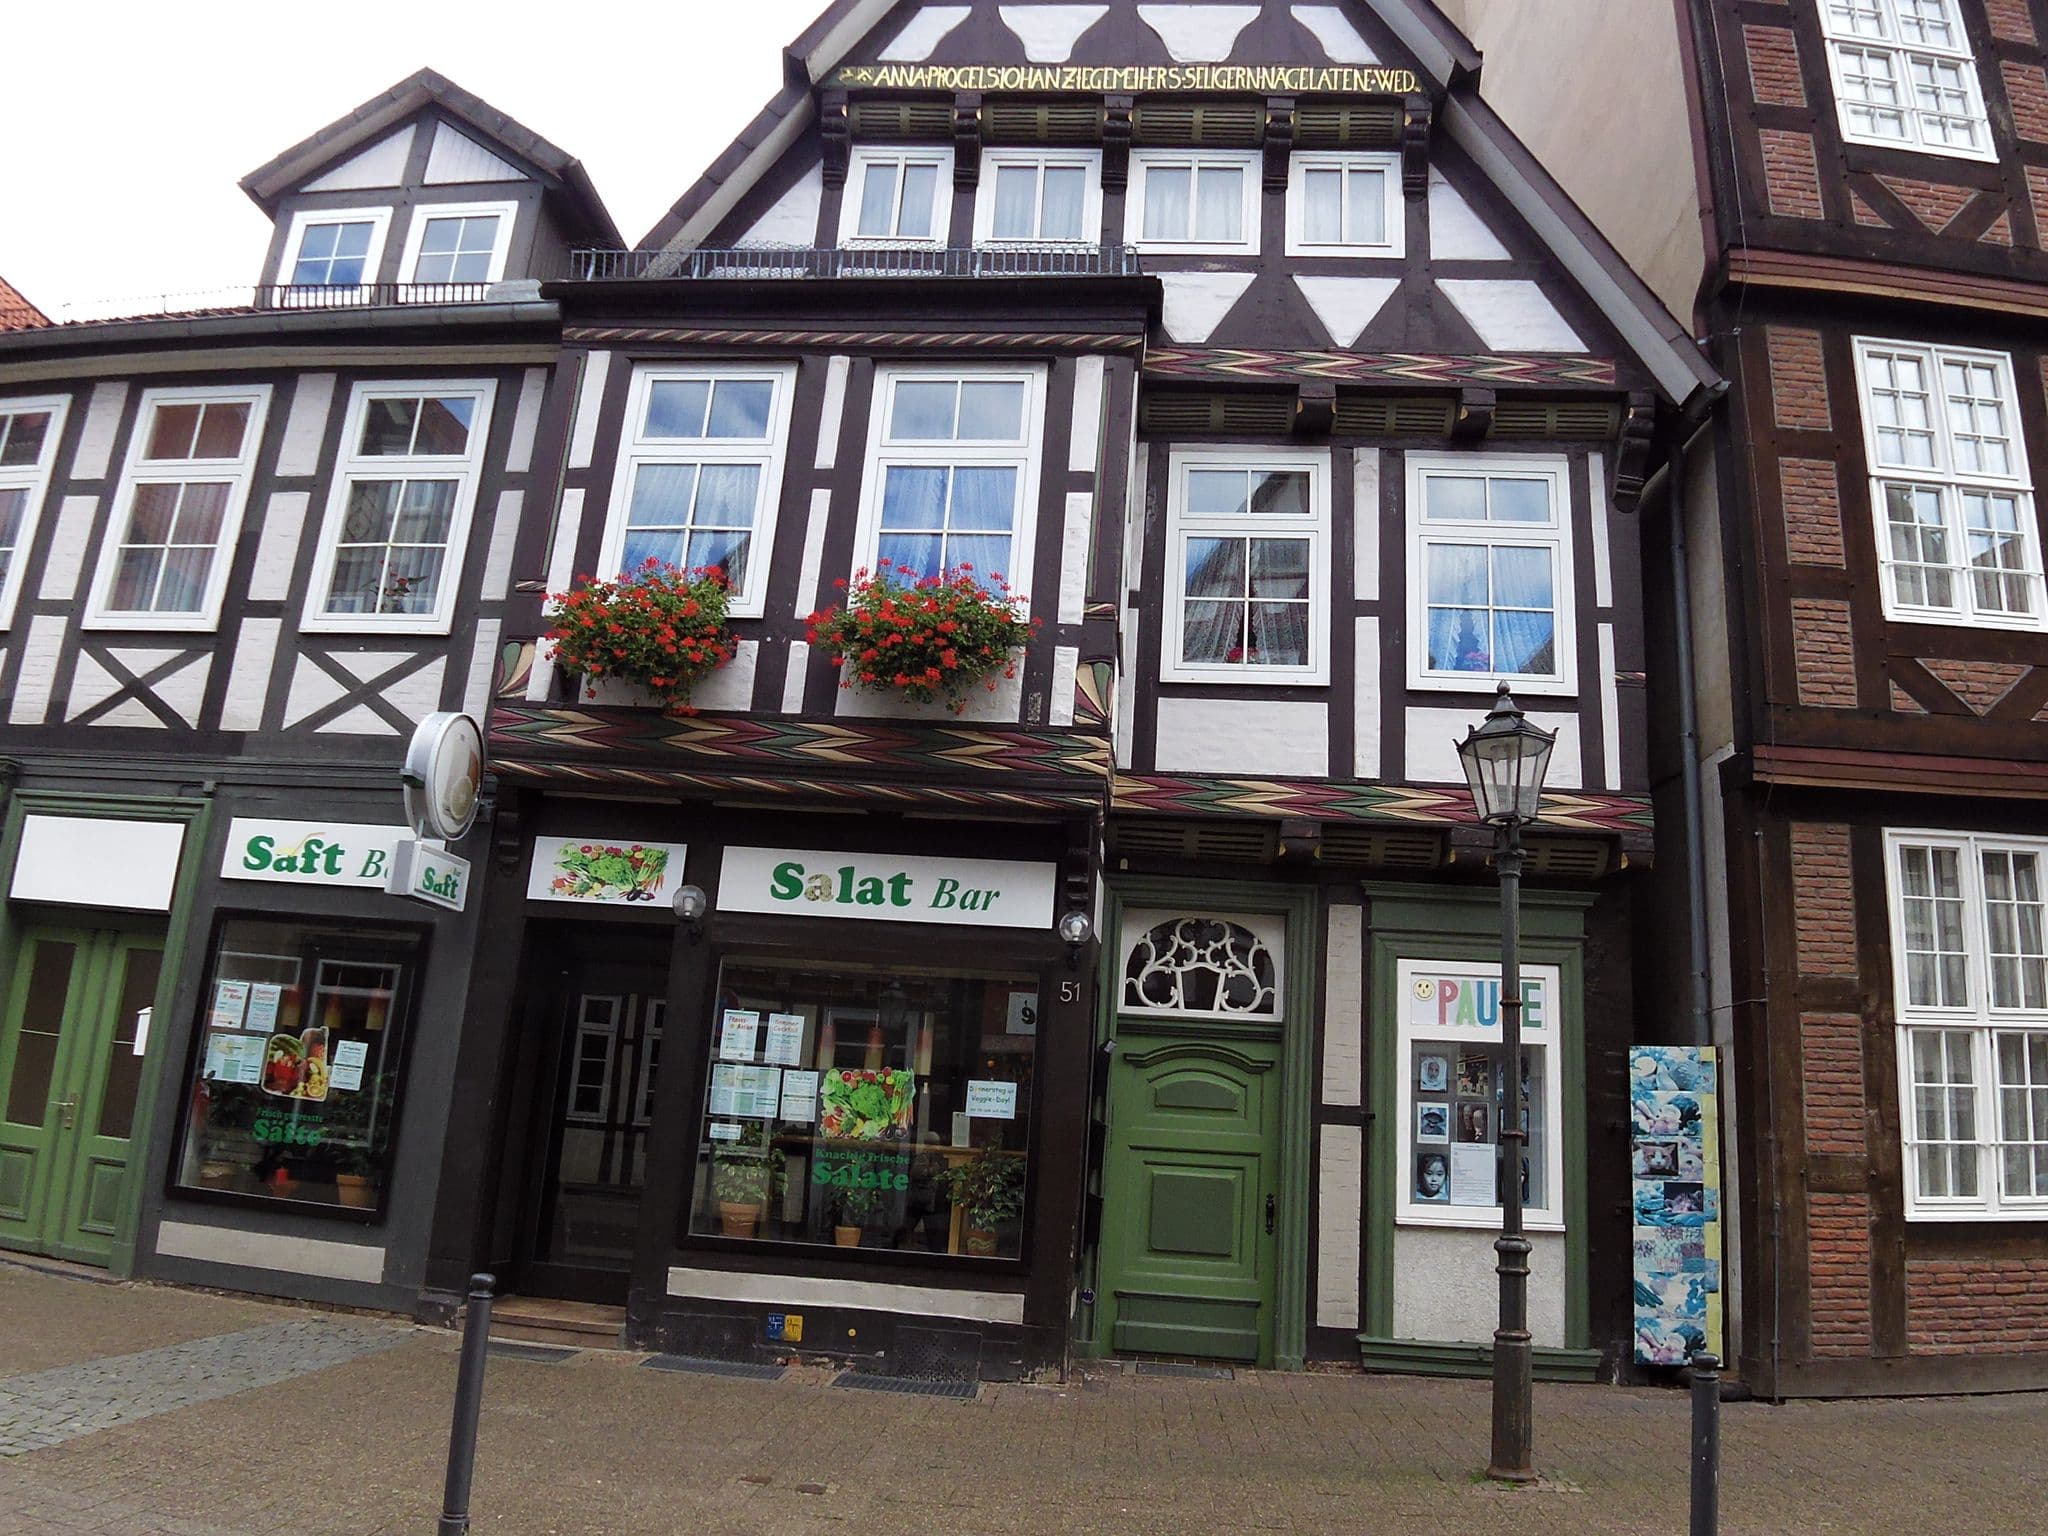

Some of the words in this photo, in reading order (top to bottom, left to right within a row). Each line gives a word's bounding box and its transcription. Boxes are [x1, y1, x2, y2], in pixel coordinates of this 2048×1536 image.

[243, 835, 345, 875] Saft
[422, 866, 458, 899] Saft
[770, 861, 913, 908] Salat
[928, 877, 1001, 912] Bar
[1059, 981, 1081, 1002] 51
[1437, 979, 1542, 1029] PAUE
[251, 1118, 321, 1147] Säfte
[811, 1159, 909, 1191] Salate
